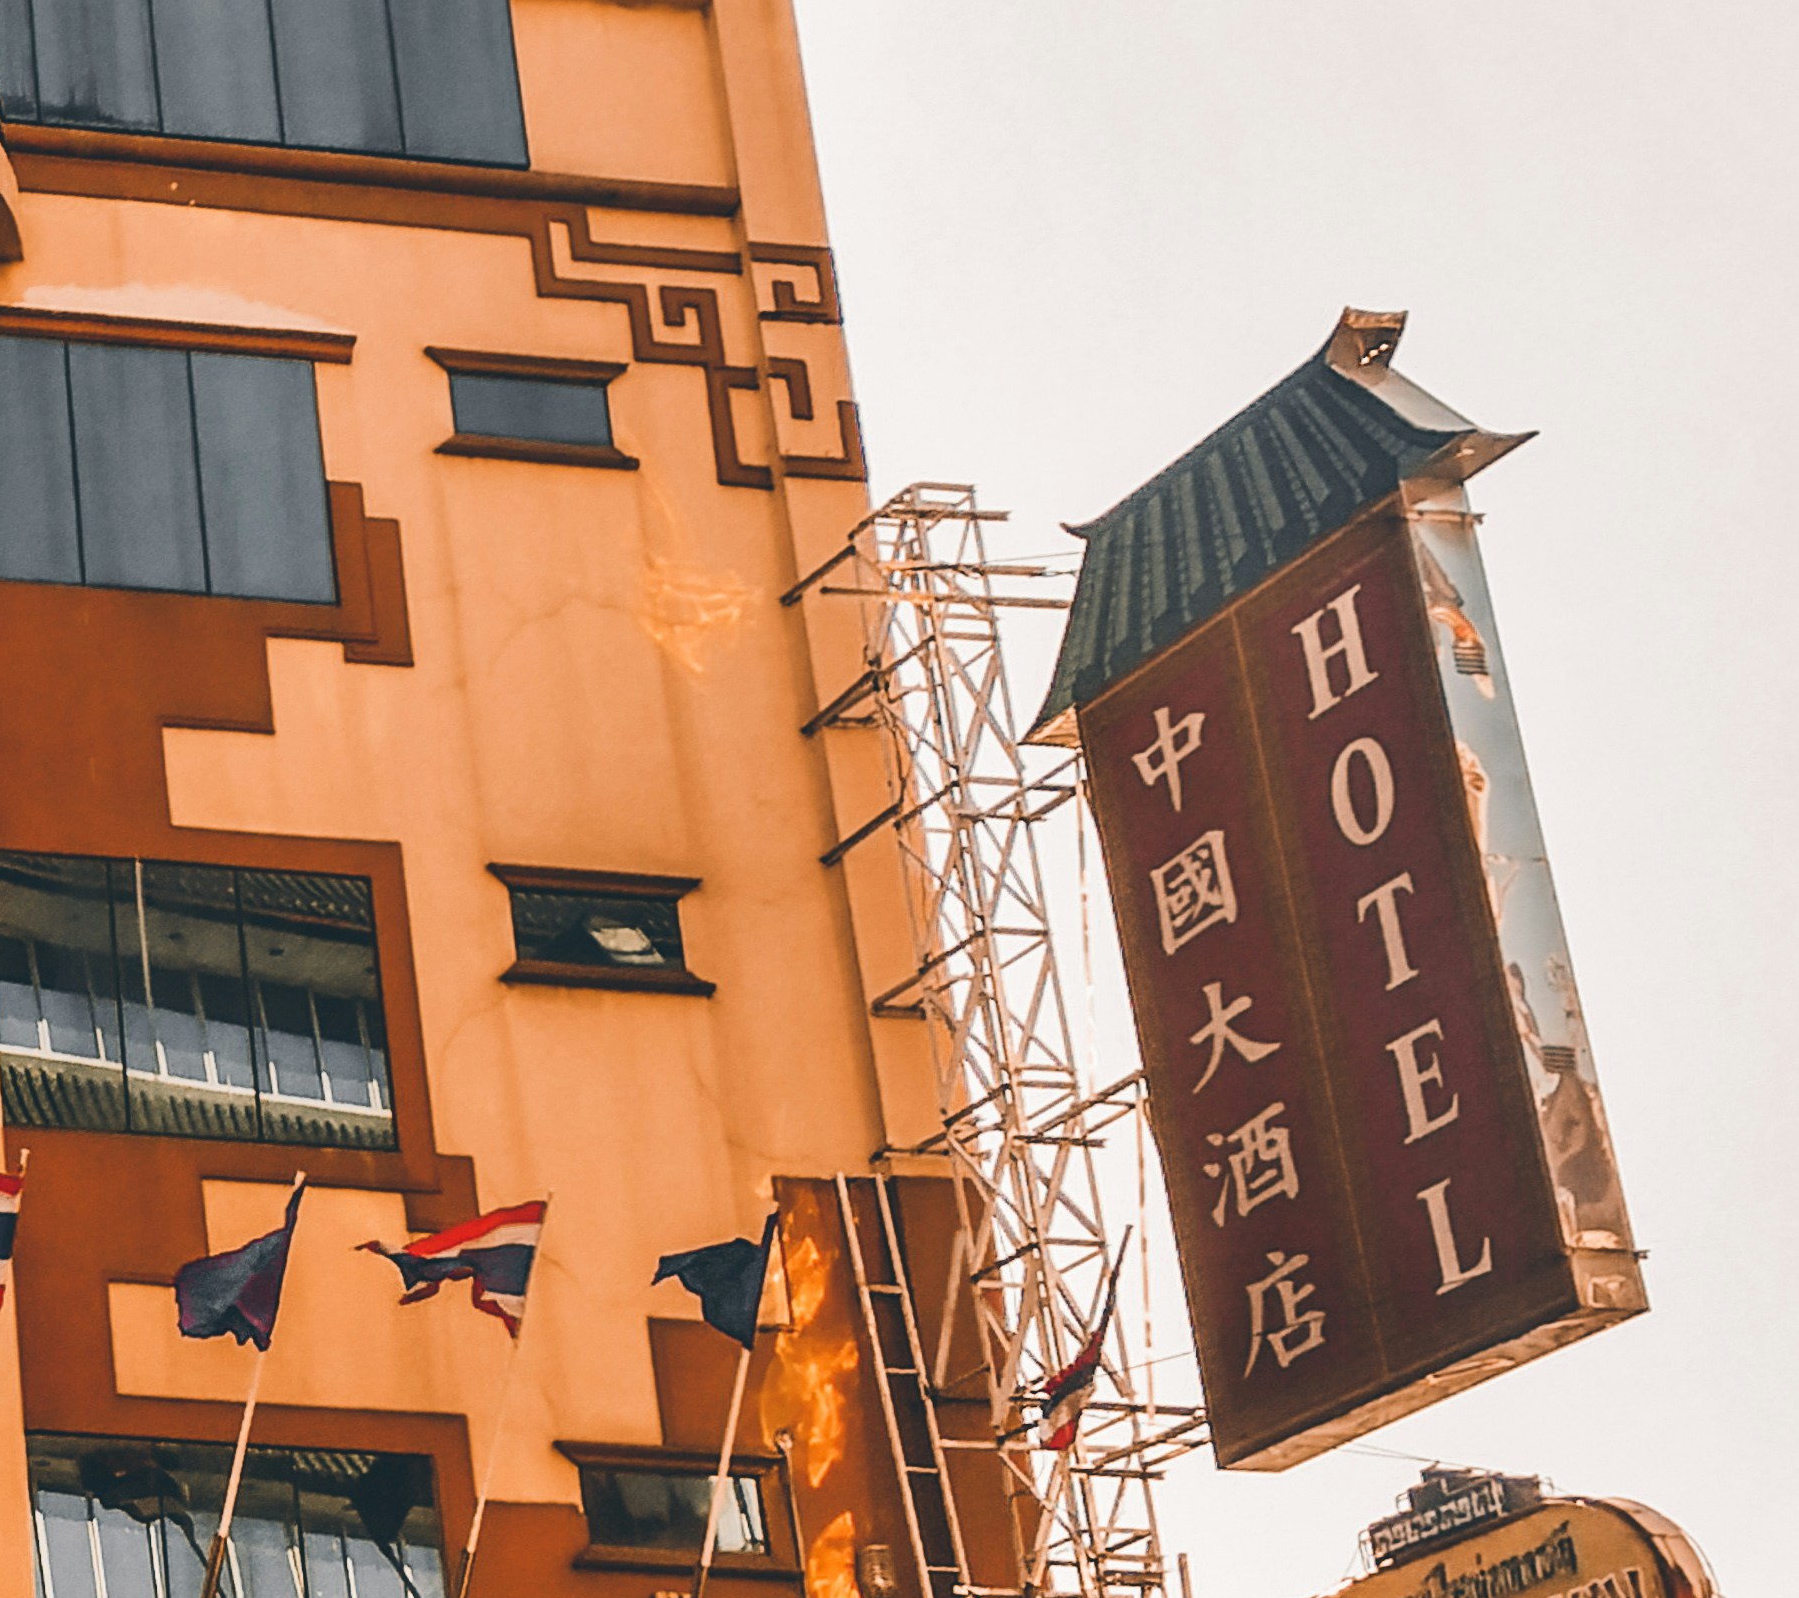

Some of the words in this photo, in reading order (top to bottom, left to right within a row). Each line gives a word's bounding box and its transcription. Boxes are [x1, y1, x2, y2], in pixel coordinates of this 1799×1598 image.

[1132, 705, 1327, 1379] 中國大酒店
[1290, 582, 1492, 1295] HOTEL
